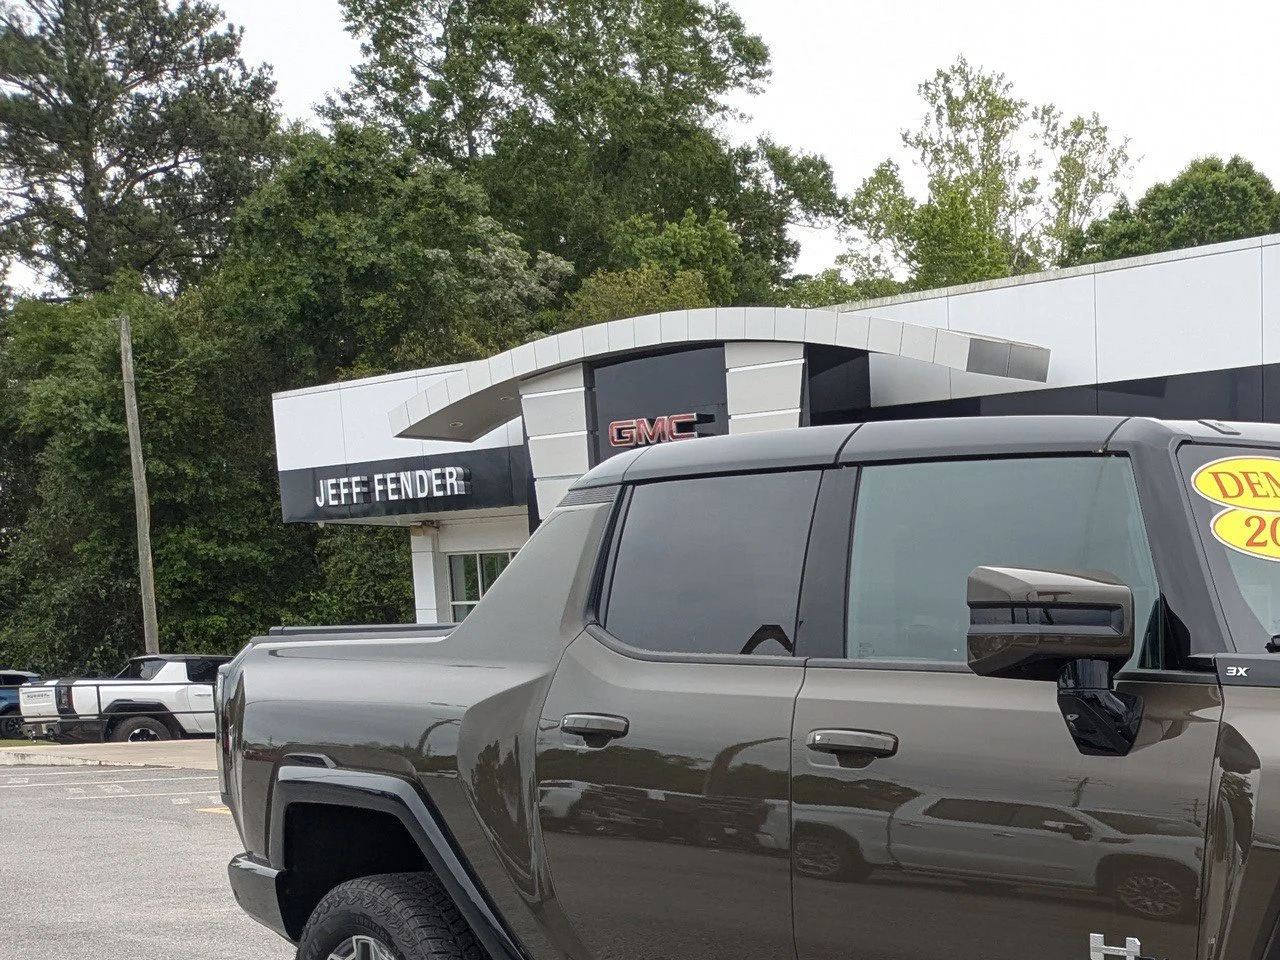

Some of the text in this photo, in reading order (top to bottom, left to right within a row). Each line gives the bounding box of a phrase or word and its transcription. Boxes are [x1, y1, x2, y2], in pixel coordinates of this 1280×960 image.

[608, 412, 698, 447] GMC
[315, 467, 459, 507] JEFF FENDER
[1226, 666, 1250, 677] 3X
